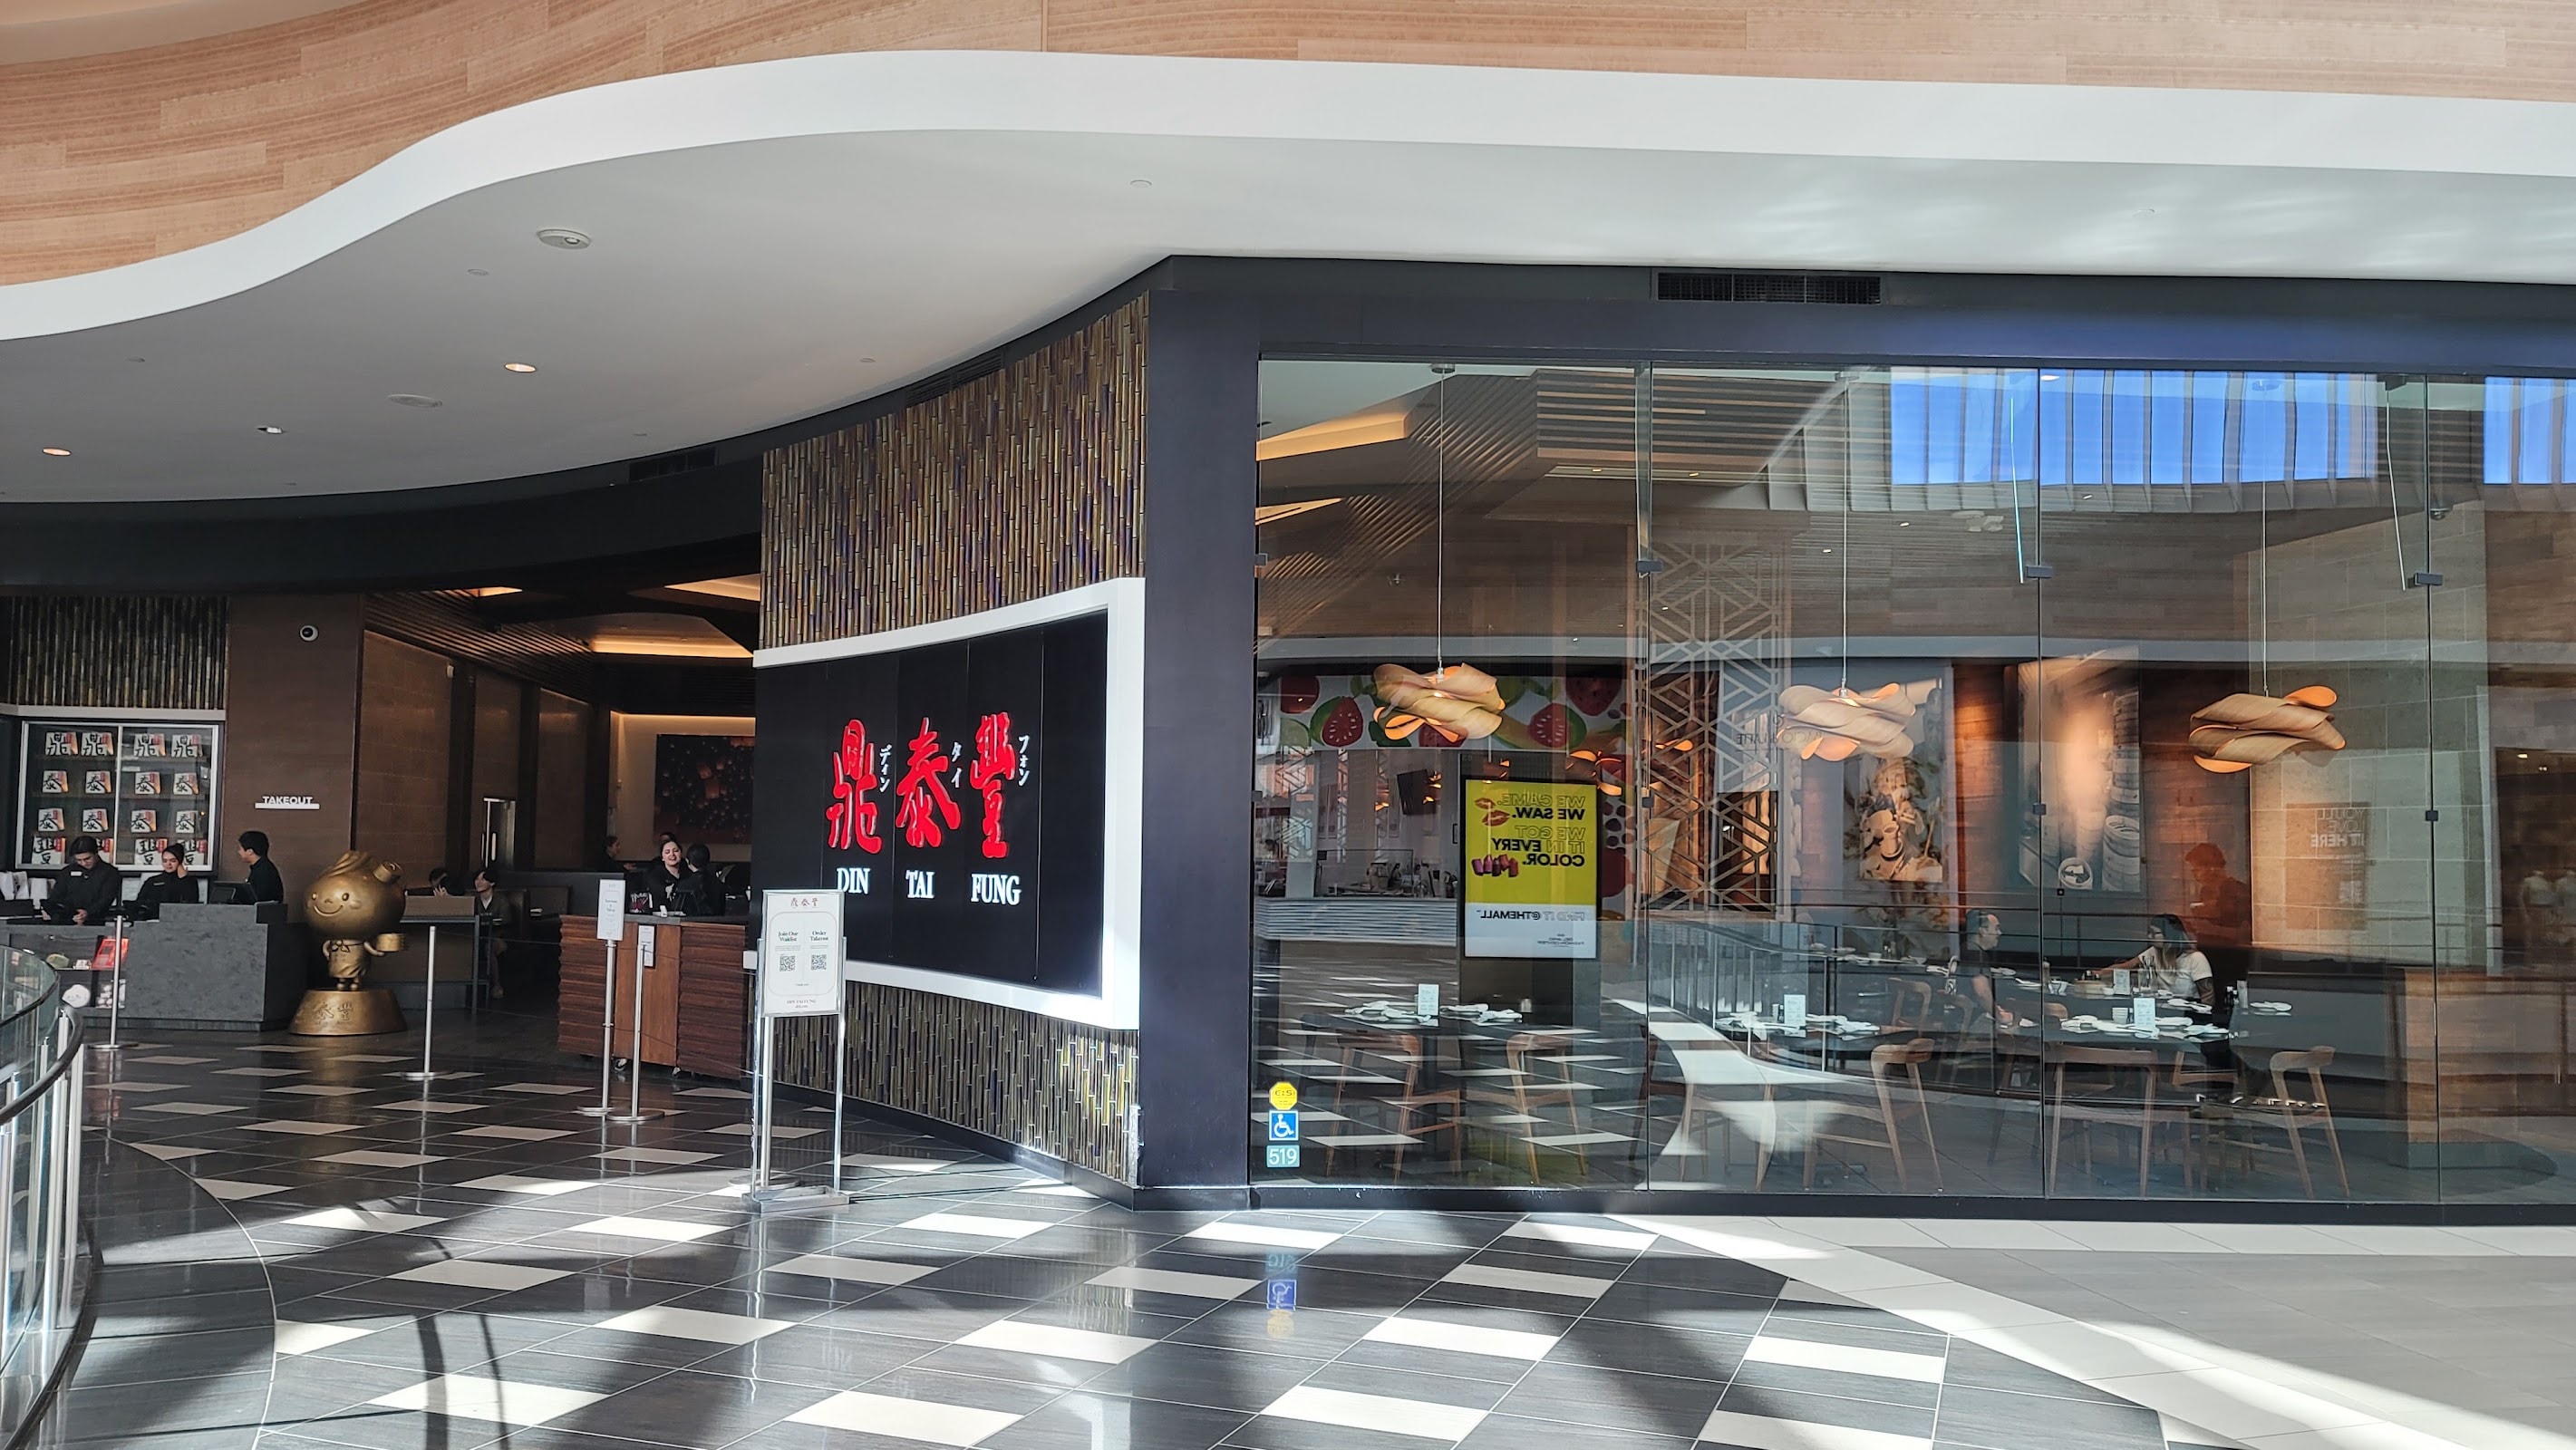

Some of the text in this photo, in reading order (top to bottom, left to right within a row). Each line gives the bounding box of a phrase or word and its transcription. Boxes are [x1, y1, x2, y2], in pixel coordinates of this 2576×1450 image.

[951, 741, 963, 788] タイ
[262, 796, 314, 805] TAKEOUT
[826, 711, 1015, 858] 鼎泰豐
[836, 867, 1022, 905] DIN TAI FUNG
[1269, 1147, 1297, 1165] 519
